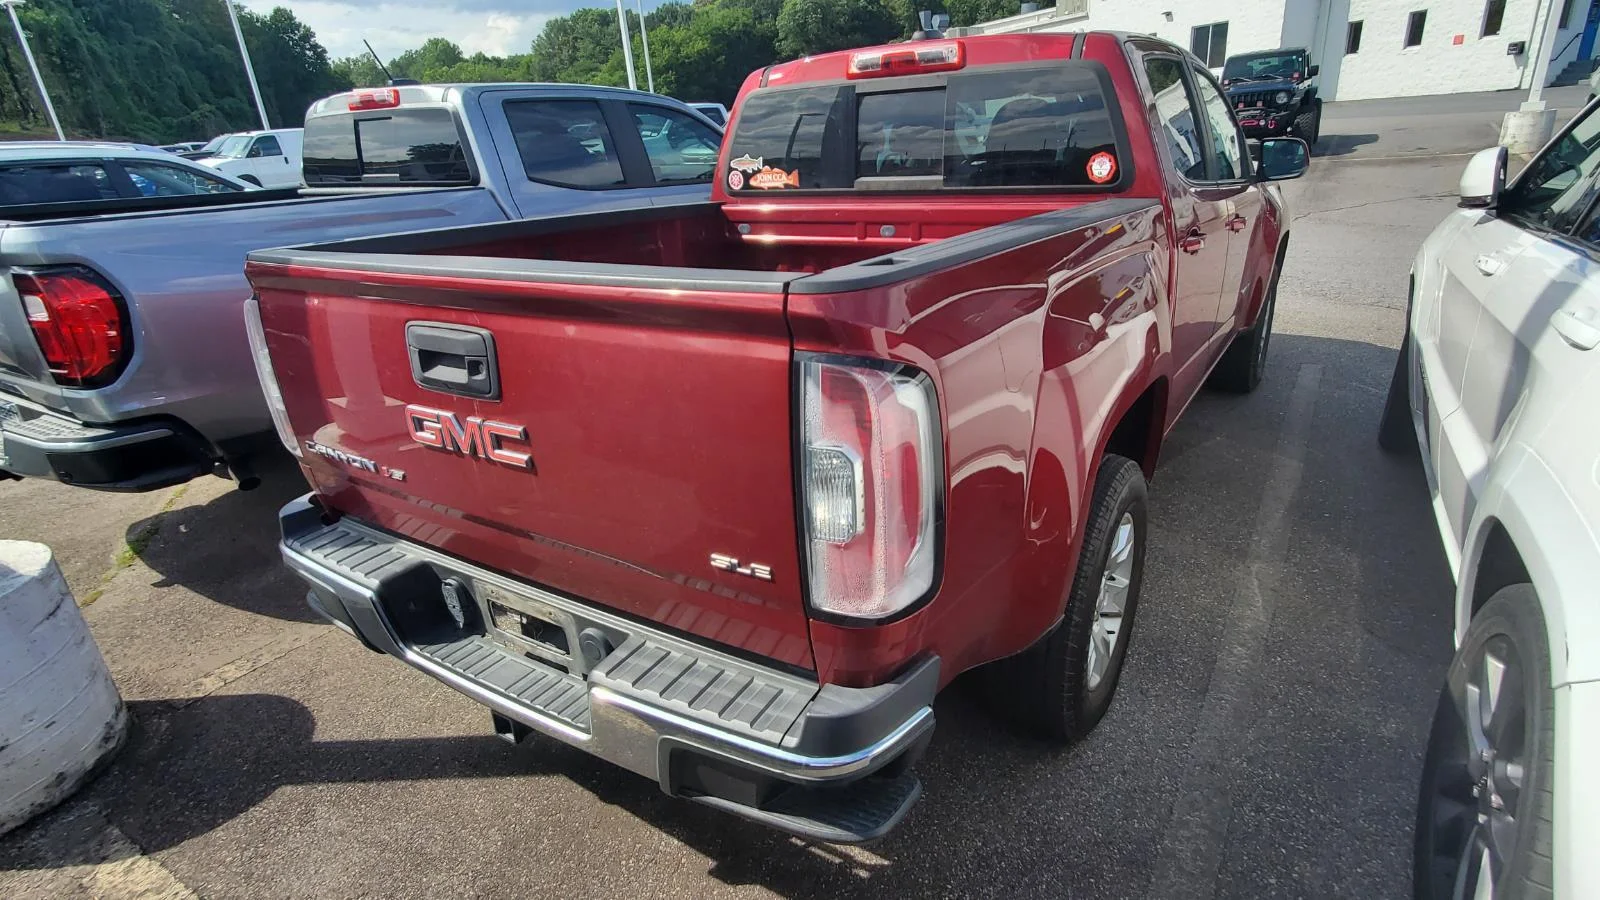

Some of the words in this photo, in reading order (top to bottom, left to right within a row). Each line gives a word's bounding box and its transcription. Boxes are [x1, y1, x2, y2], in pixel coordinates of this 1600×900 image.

[758, 173, 773, 181] JOIN
[773, 173, 787, 181] CCA
[405, 403, 533, 469] GMC
[305, 440, 378, 473] CANYON
[710, 553, 772, 580] SLE
